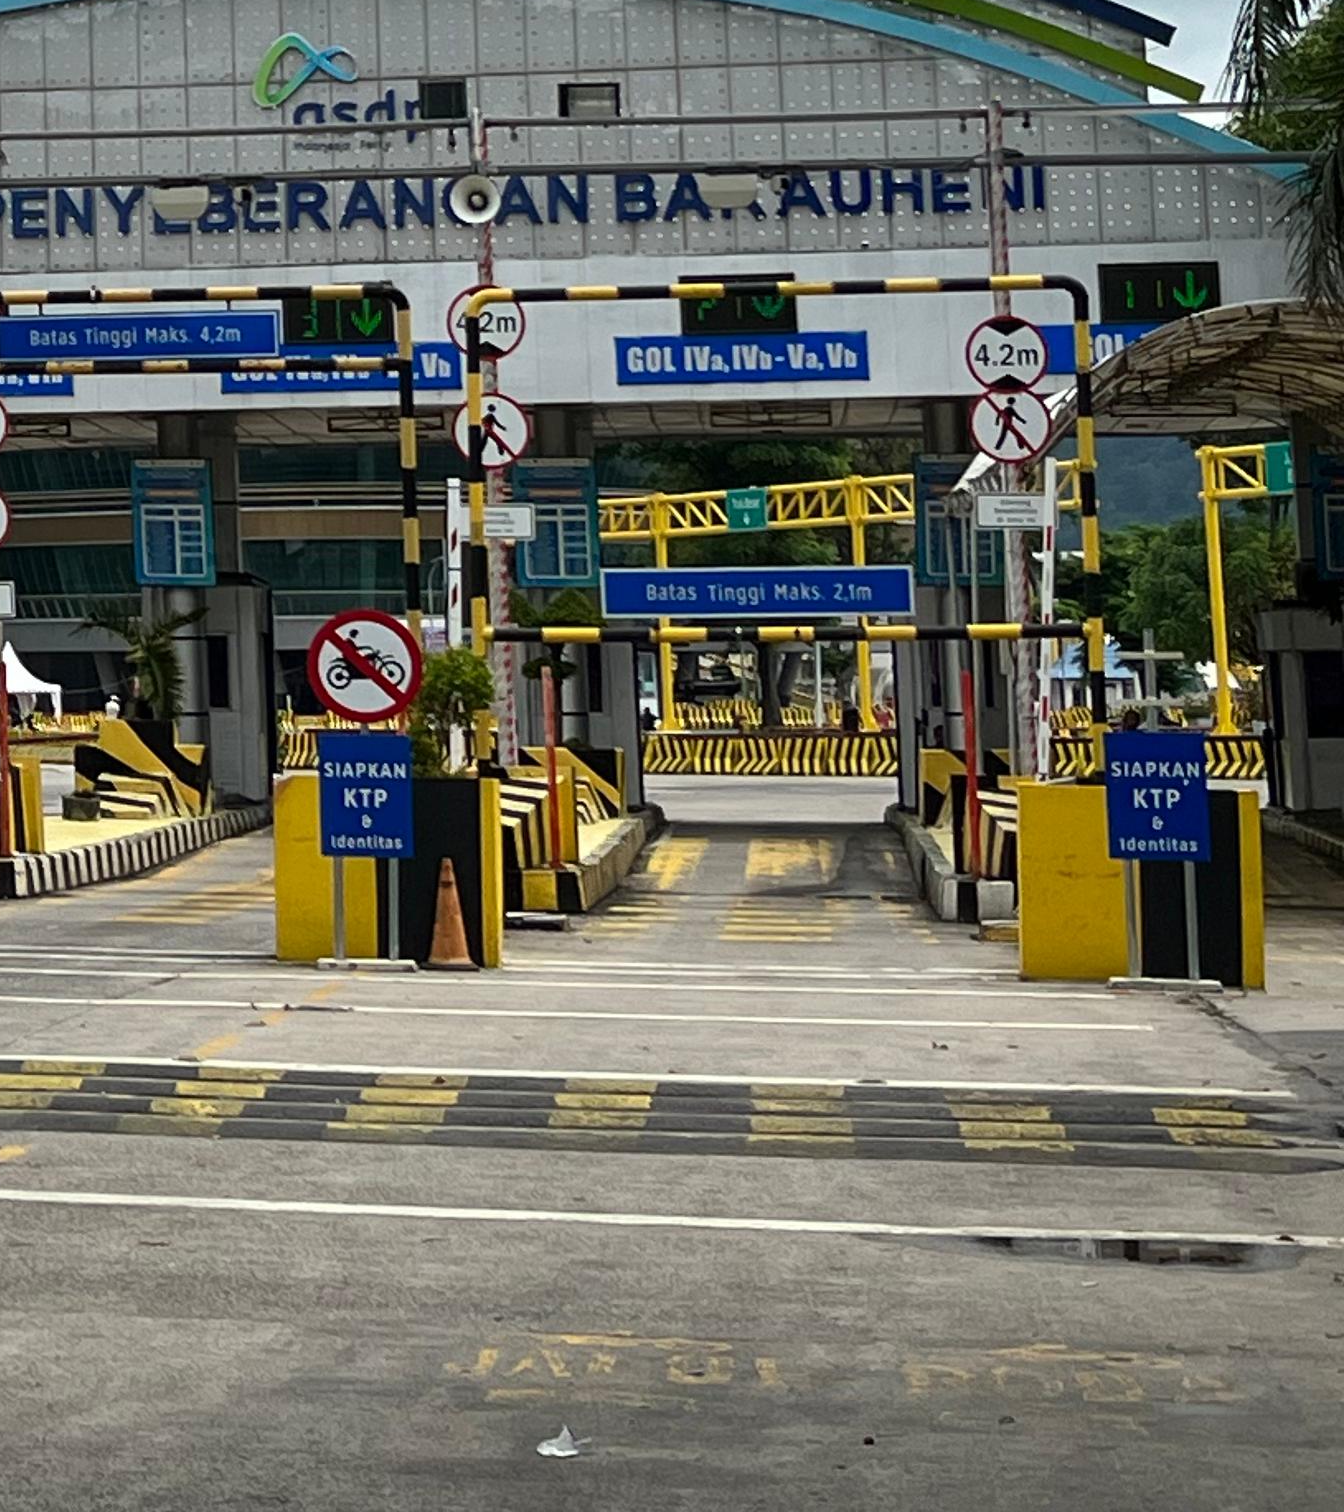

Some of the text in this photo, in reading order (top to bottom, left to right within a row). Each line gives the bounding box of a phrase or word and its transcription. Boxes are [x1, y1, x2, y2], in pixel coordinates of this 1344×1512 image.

[615, 166, 1044, 222] BAAUHENI
[455, 310, 517, 334] 42m
[30, 329, 78, 347] Batas
[84, 326, 137, 348] Tinggi
[626, 345, 677, 373] GOL
[975, 343, 1039, 367] 4.2m
[646, 584, 697, 601] Batas
[707, 583, 765, 605] Tinggi
[323, 762, 406, 779] SIAPKAN
[1111, 761, 1200, 778] SIAPKAN
[344, 788, 388, 808] KTP
[1133, 789, 1180, 809] KTP
[331, 834, 403, 850] Identitas
[1119, 837, 1198, 852] Identitas
